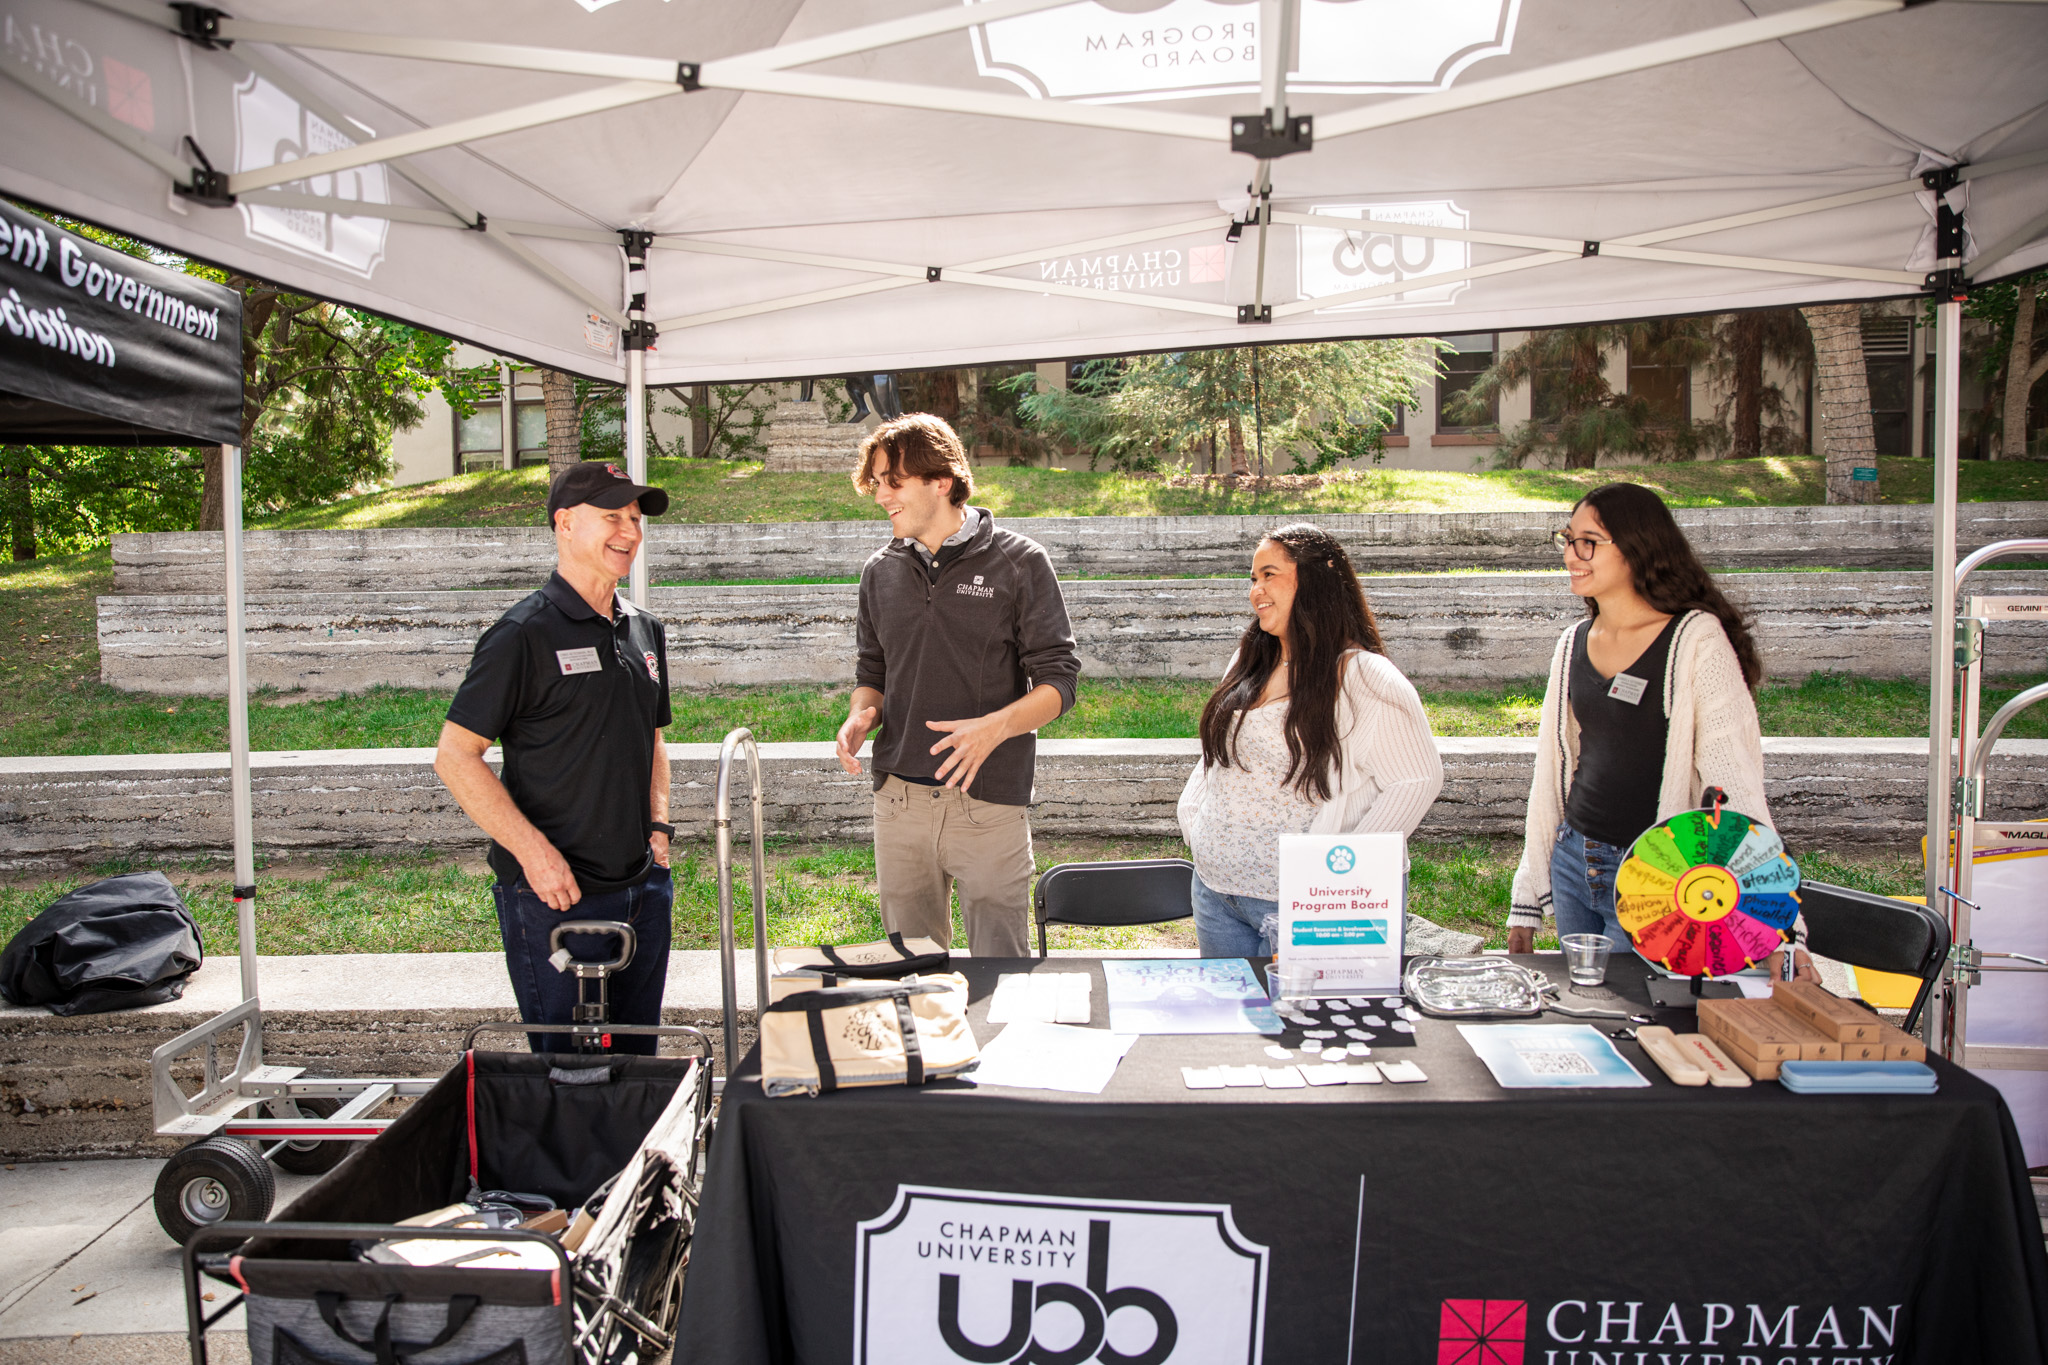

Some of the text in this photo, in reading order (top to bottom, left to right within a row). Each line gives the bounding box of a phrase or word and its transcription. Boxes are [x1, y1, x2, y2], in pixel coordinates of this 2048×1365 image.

[59, 236, 220, 341] Government
[0, 287, 116, 368] ciation
[956, 588, 994, 598] UNIVERSITY
[957, 583, 994, 593] CHAPMAN
[1309, 885, 1372, 898] University
[1292, 899, 1389, 913] Program Board
[940, 1221, 1077, 1247] CHAPMAN
[918, 1241, 1077, 1269] UNIVERSITY
[1545, 1299, 1904, 1350] CHAPMAN
